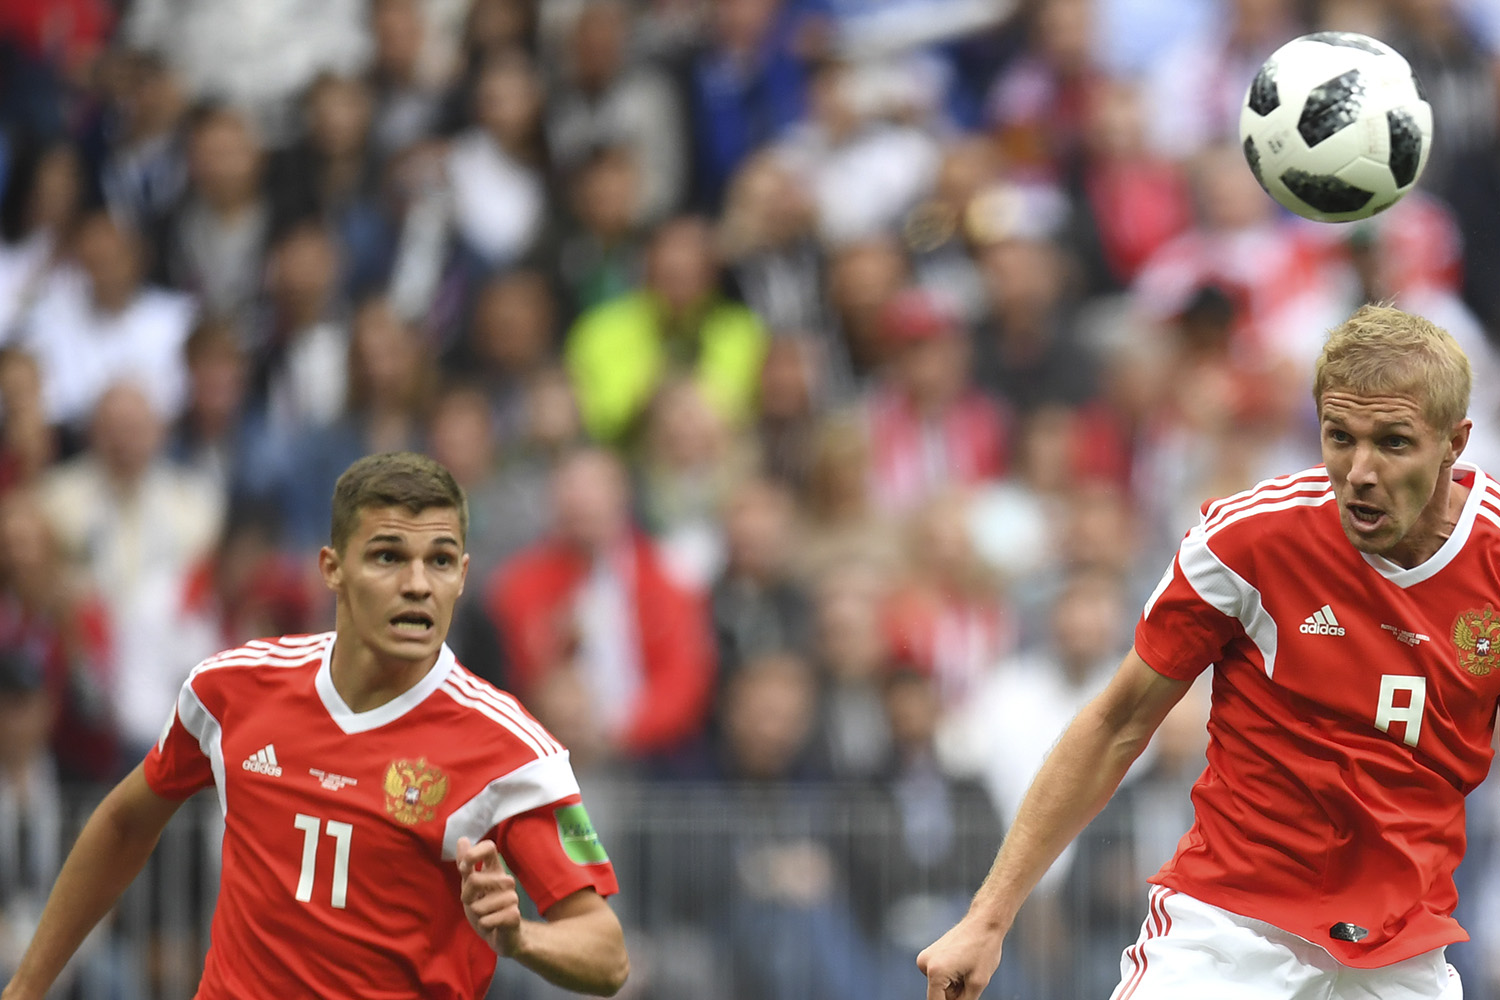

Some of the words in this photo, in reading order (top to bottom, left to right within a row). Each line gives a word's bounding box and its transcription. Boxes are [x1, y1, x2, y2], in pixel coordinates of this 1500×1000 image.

[1299, 622, 1346, 637] adidas
[242, 759, 283, 778] adidas
[294, 813, 354, 909] 11
